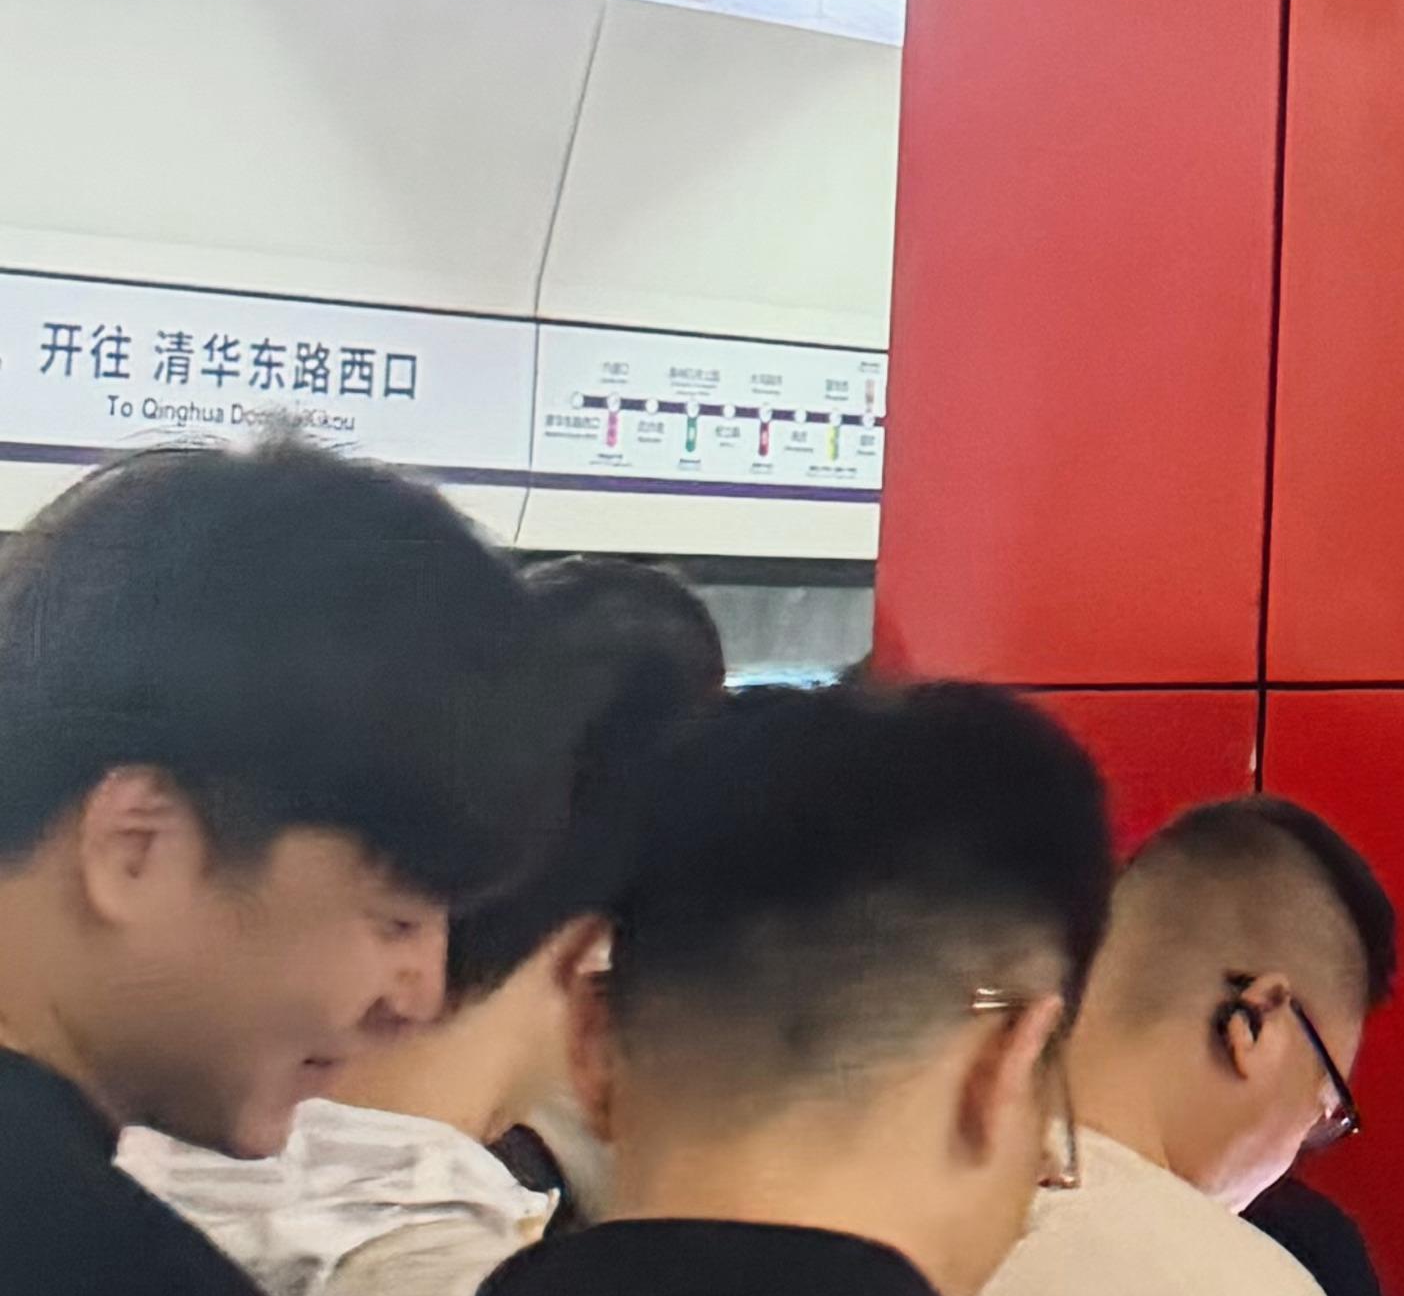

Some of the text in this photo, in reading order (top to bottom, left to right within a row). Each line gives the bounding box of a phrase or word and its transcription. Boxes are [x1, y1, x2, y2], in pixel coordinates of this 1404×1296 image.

[39, 321, 419, 399] 开往 清华东路西口
[108, 394, 133, 418] To
[142, 397, 225, 427] Qinghua
